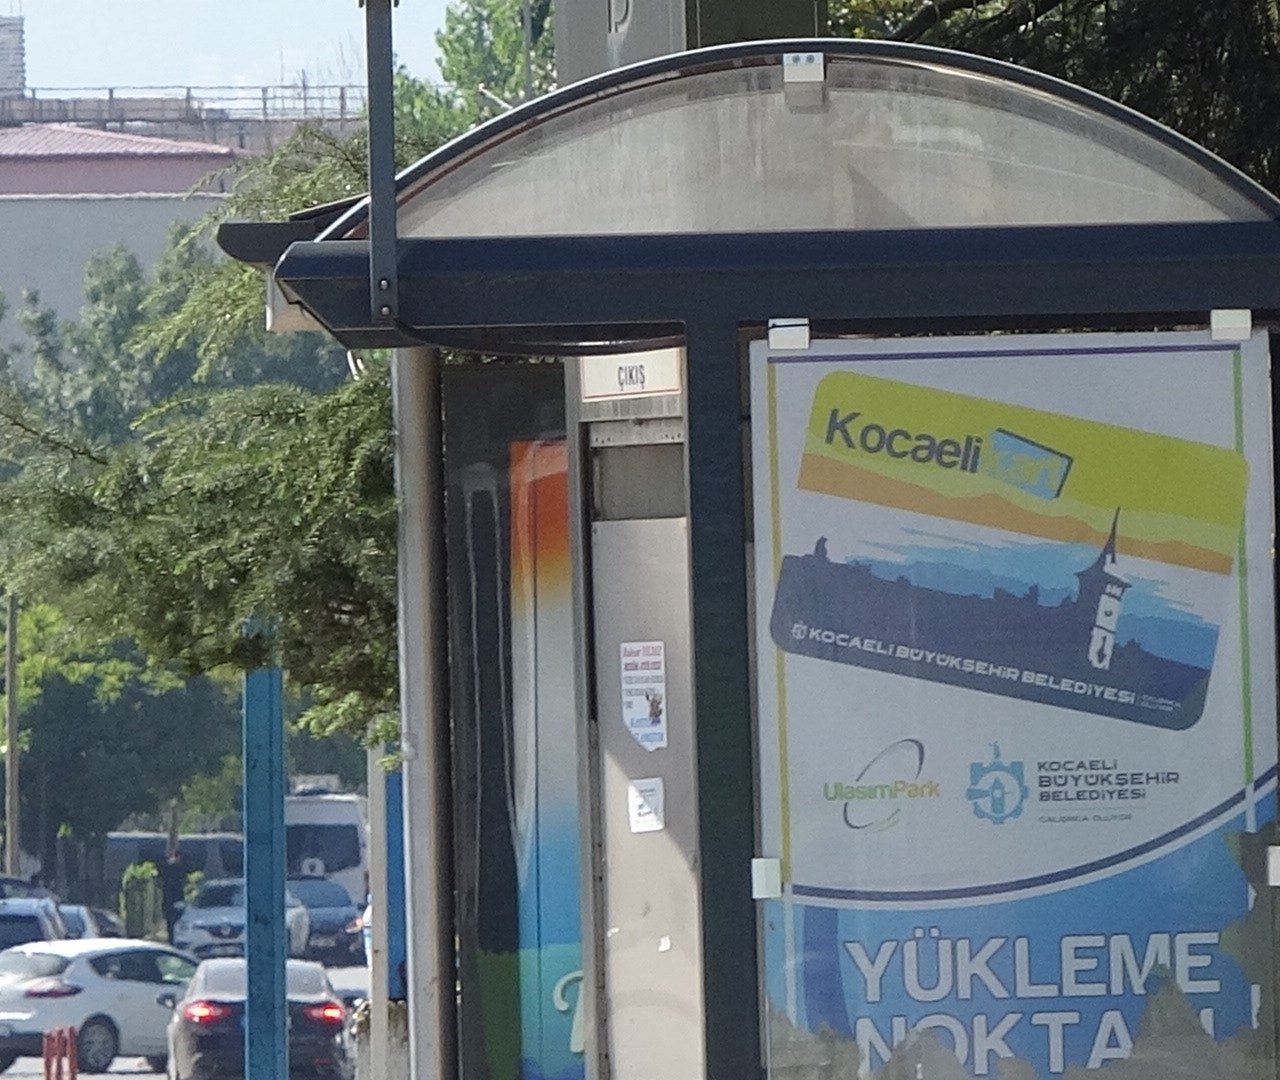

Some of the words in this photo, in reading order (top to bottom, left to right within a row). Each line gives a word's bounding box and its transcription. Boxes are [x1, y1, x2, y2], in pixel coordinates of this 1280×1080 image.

[618, 364, 645, 391] ÇIKIŞ
[825, 408, 983, 474] Kocaeli
[843, 926, 1221, 1004] YÜKLEME
[855, 1007, 1215, 1075] NOKTA
